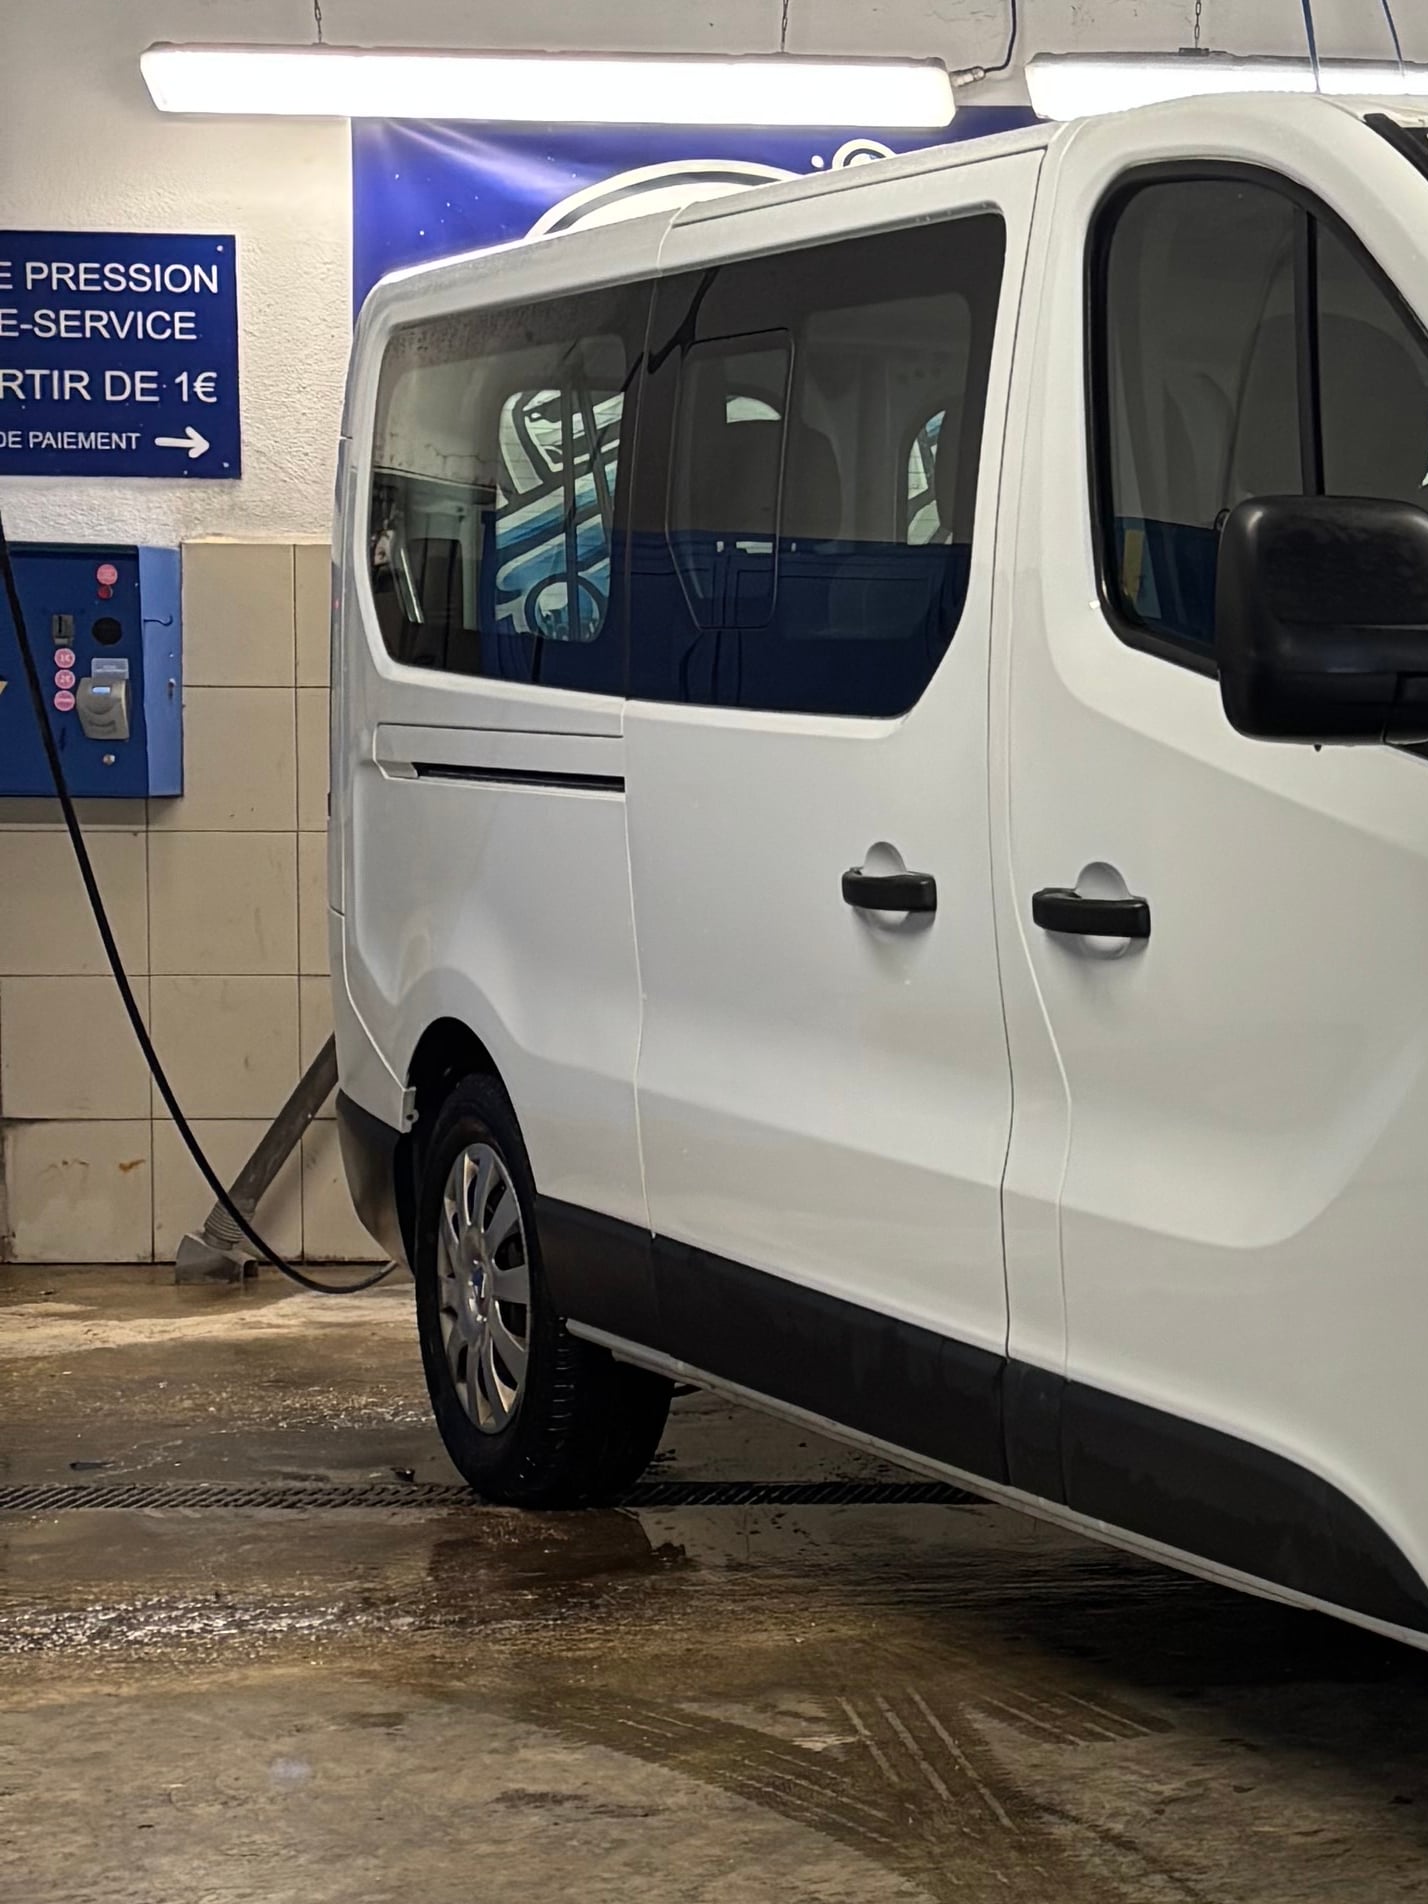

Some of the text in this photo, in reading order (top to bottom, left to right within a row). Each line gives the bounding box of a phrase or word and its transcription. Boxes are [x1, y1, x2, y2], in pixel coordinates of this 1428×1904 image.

[25, 261, 219, 294] PRESSION
[104, 370, 160, 402] DE
[175, 371, 218, 403] 1€
[28, 431, 142, 450] PAIEMENT
